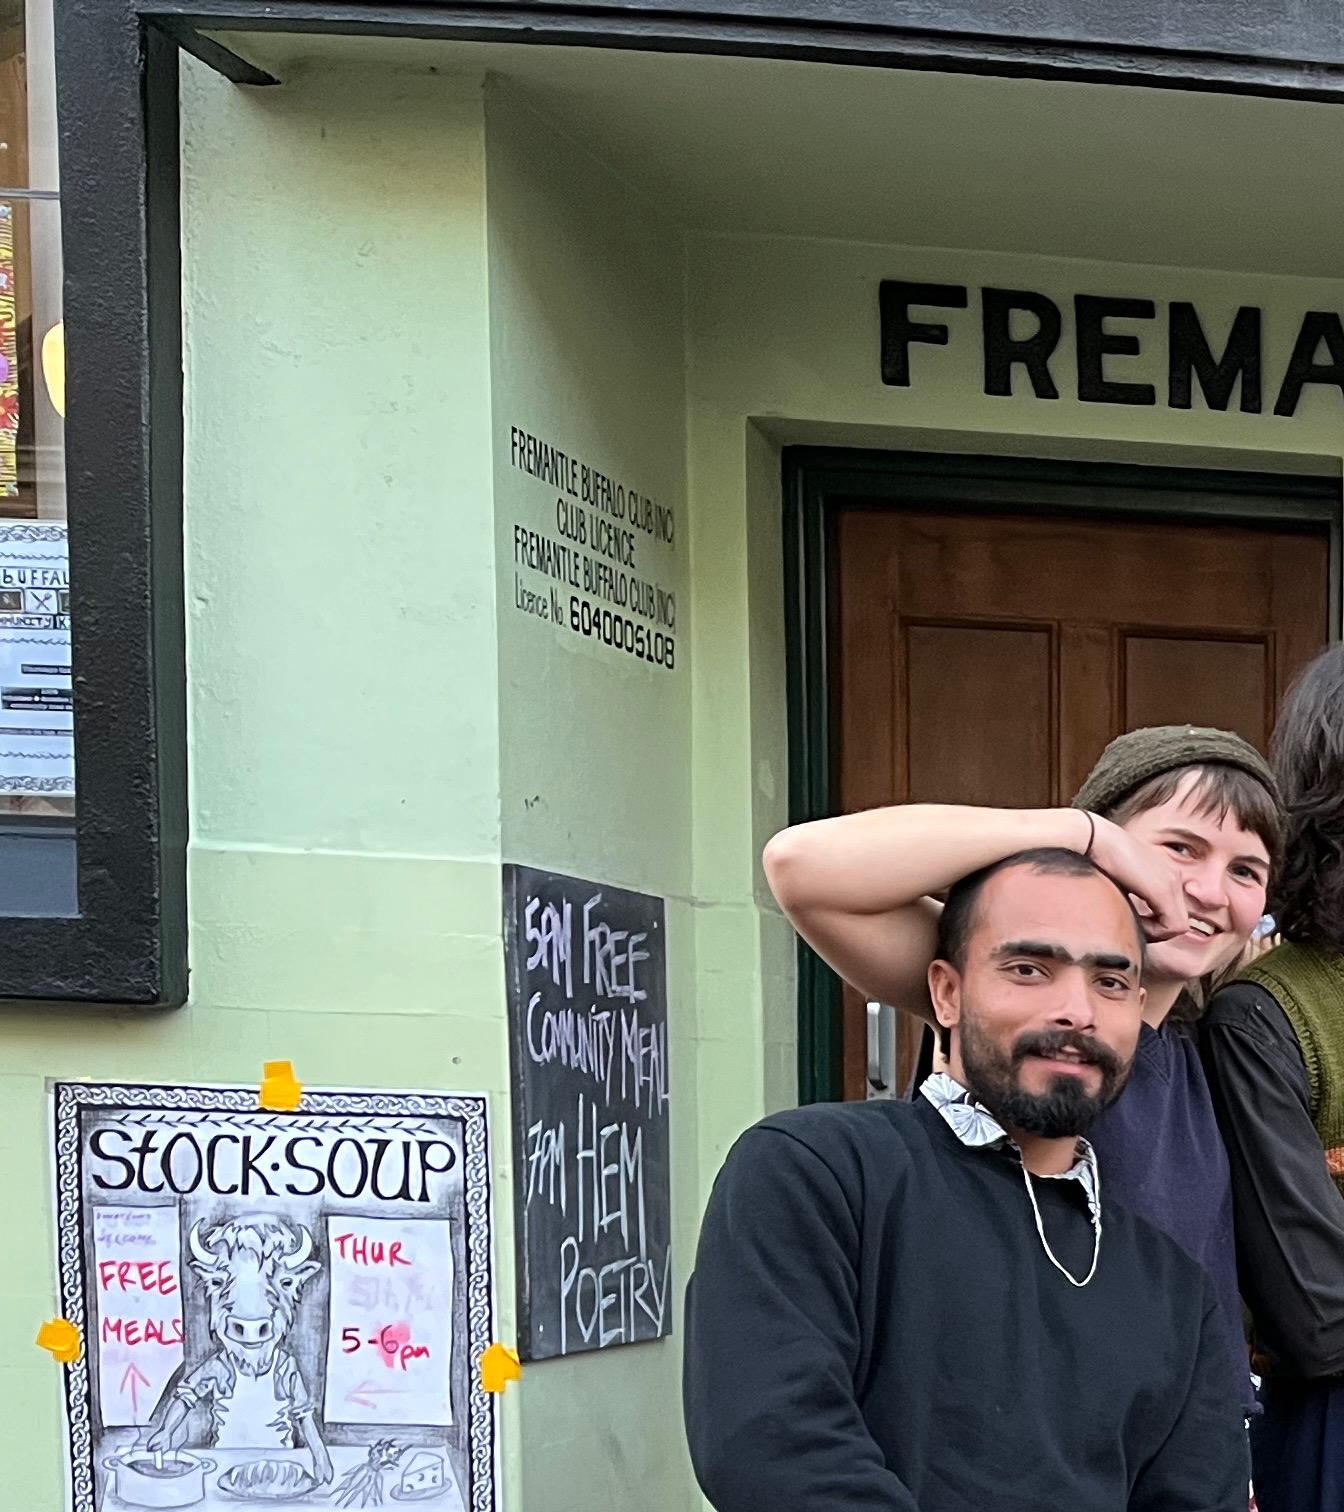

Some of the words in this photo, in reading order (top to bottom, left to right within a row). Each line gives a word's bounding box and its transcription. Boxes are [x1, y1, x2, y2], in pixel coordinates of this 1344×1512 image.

[511, 425, 578, 498] FREMANTLE
[581, 464, 625, 519] BUFFALO
[628, 490, 653, 534] CLUB
[514, 524, 580, 588] FREMANTLE
[583, 555, 628, 607] BUFFALO
[630, 577, 655, 620] CLUB
[557, 498, 586, 545] CLUB
[590, 514, 635, 569] LICENCE
[515, 571, 549, 620] Licence
[570, 595, 675, 670] 6040005108
[583, 893, 650, 1003] FREE
[576, 1093, 646, 1261] HEM
[99, 1261, 177, 1295] FREE
[334, 1233, 412, 1267] THUR
[560, 1236, 671, 1355] POETRY
[103, 1316, 185, 1345] MEALS
